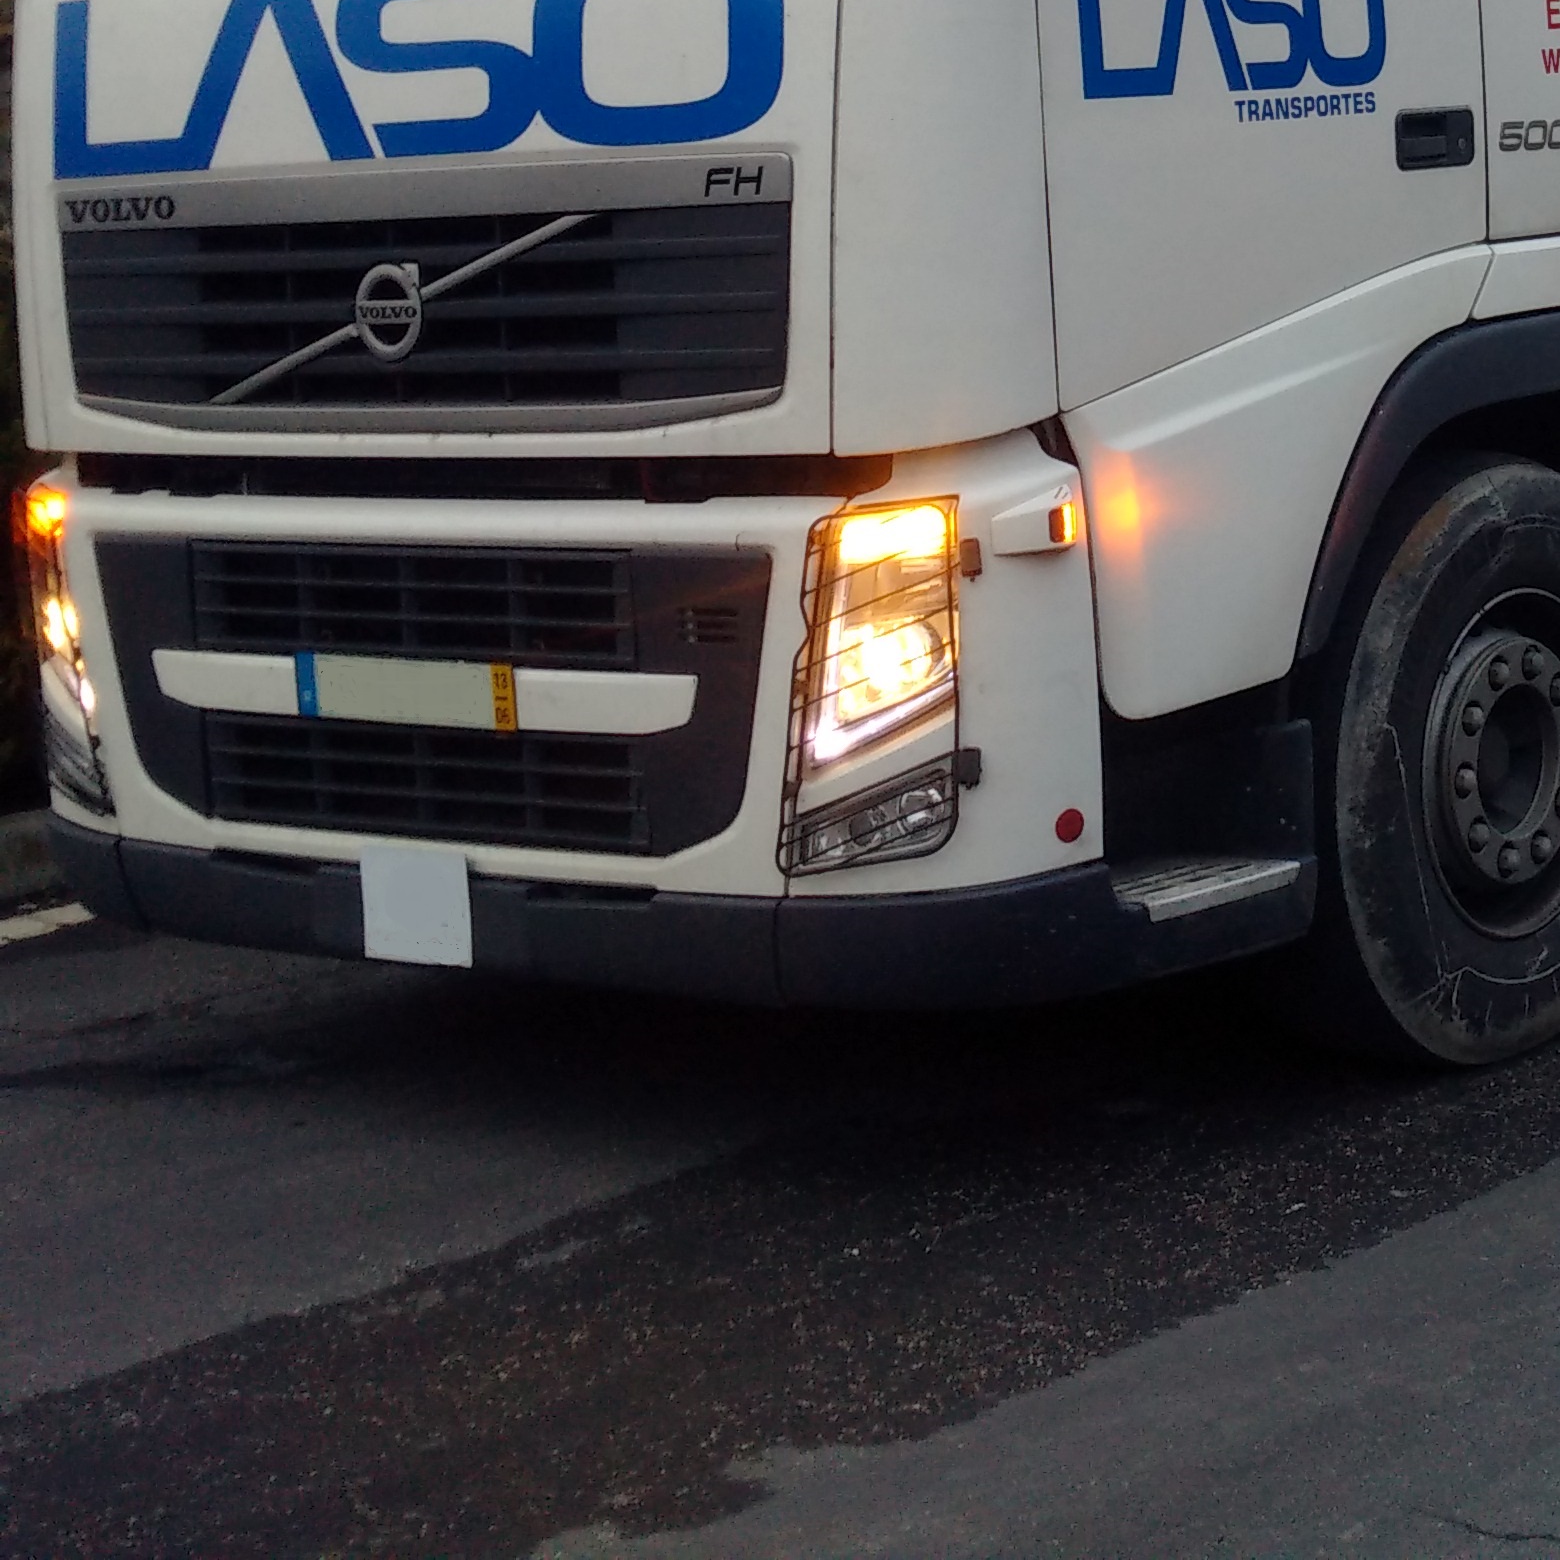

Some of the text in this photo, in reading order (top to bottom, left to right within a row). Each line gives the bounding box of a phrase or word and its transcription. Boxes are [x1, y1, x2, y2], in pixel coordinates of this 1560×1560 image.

[1235, 91, 1377, 123] TRANSPORTES
[704, 166, 764, 198] FH
[68, 194, 176, 225] VOLVO
[358, 304, 418, 323] VOLVO
